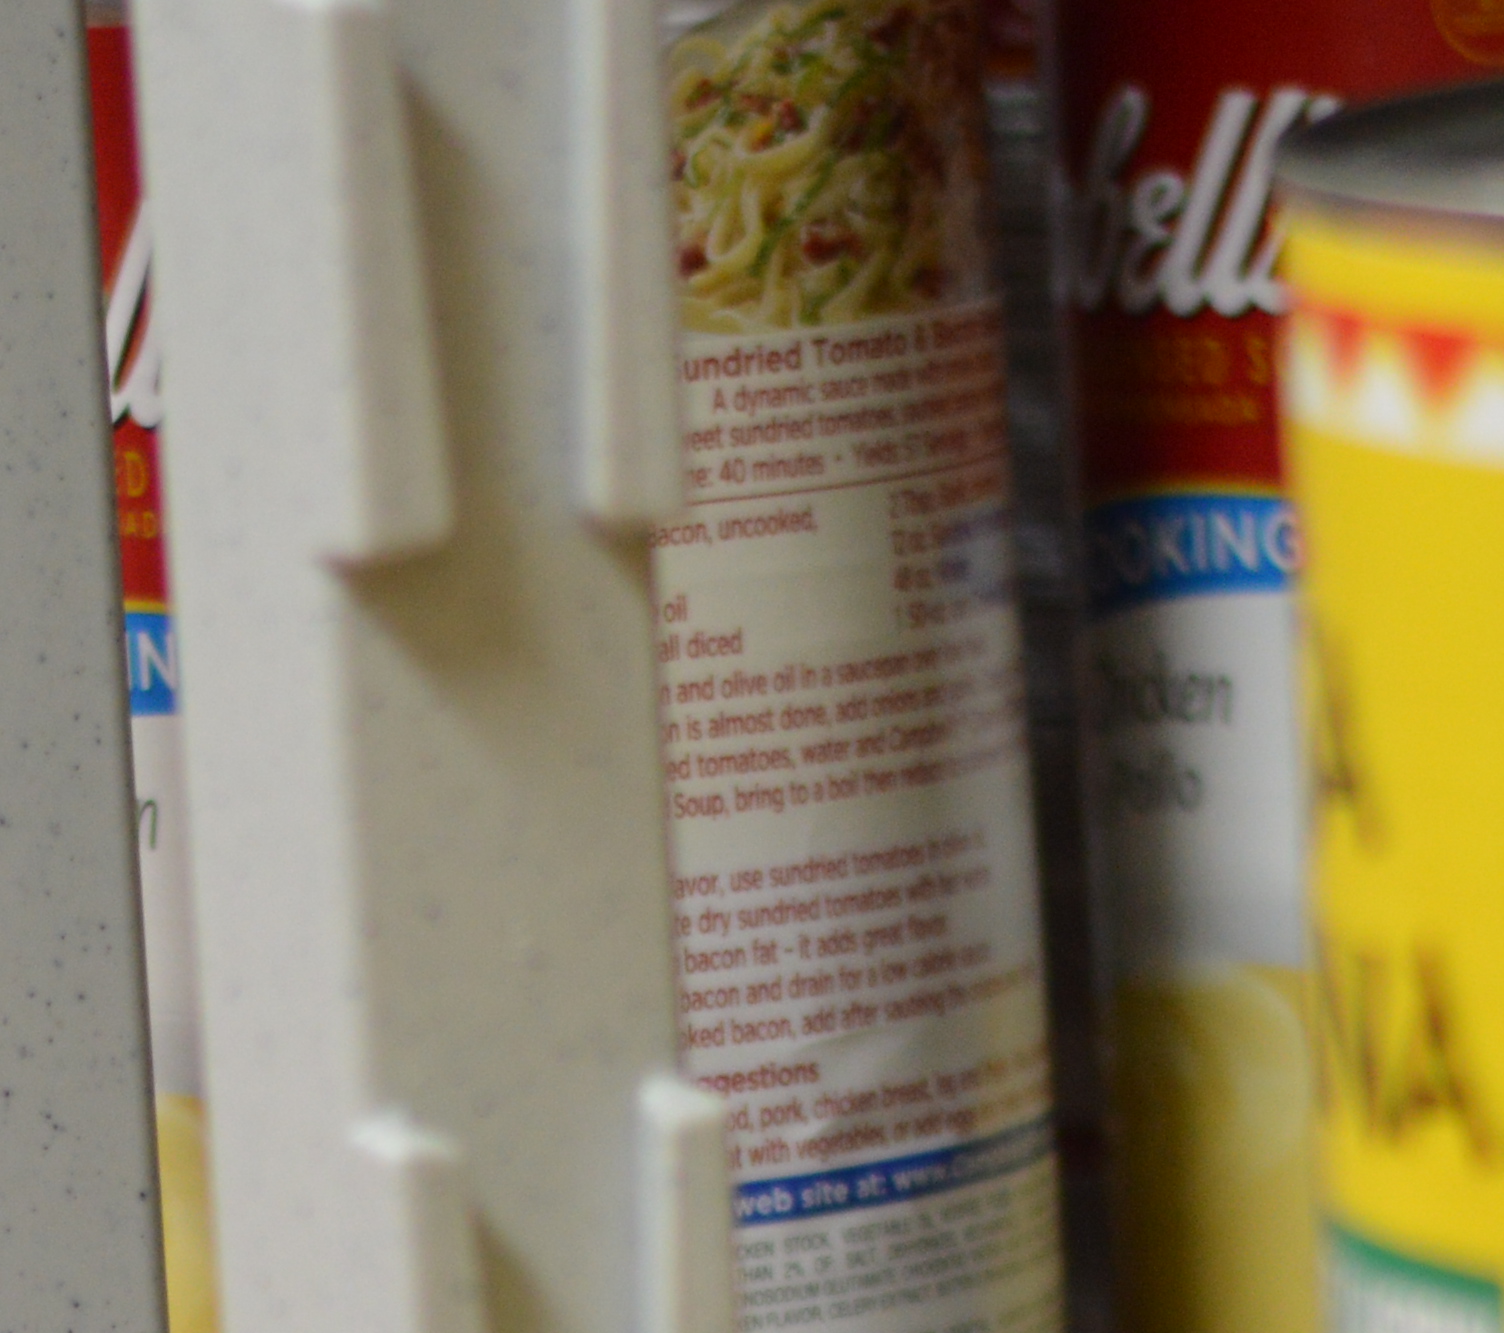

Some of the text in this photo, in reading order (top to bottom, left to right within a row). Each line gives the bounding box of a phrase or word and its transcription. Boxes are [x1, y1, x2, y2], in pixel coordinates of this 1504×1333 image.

[682, 341, 802, 383] undried
[684, 425, 724, 454] eet
[729, 411, 814, 445] sundried
[718, 456, 747, 486] 40
[752, 449, 826, 483] minutes
[686, 626, 744, 662] diced
[676, 676, 716, 704] and
[720, 668, 768, 699] olive
[773, 662, 794, 692] oil
[687, 716, 701, 742] is
[707, 707, 773, 741] almost
[696, 743, 796, 778] tomatoes,
[674, 790, 729, 822] Soup,
[734, 782, 785, 814] bring
[790, 780, 809, 807] to
[730, 864, 764, 892] use
[769, 850, 850, 890] sundried
[698, 901, 732, 939] dry
[737, 897, 821, 932] sundried
[684, 940, 748, 975] bacon
[752, 937, 779, 966] fat
[746, 976, 784, 1008] and
[788, 969, 835, 1001] drain
[748, 1135, 790, 1168] with
[736, 1184, 792, 1220] web
[800, 1177, 850, 1210] site
